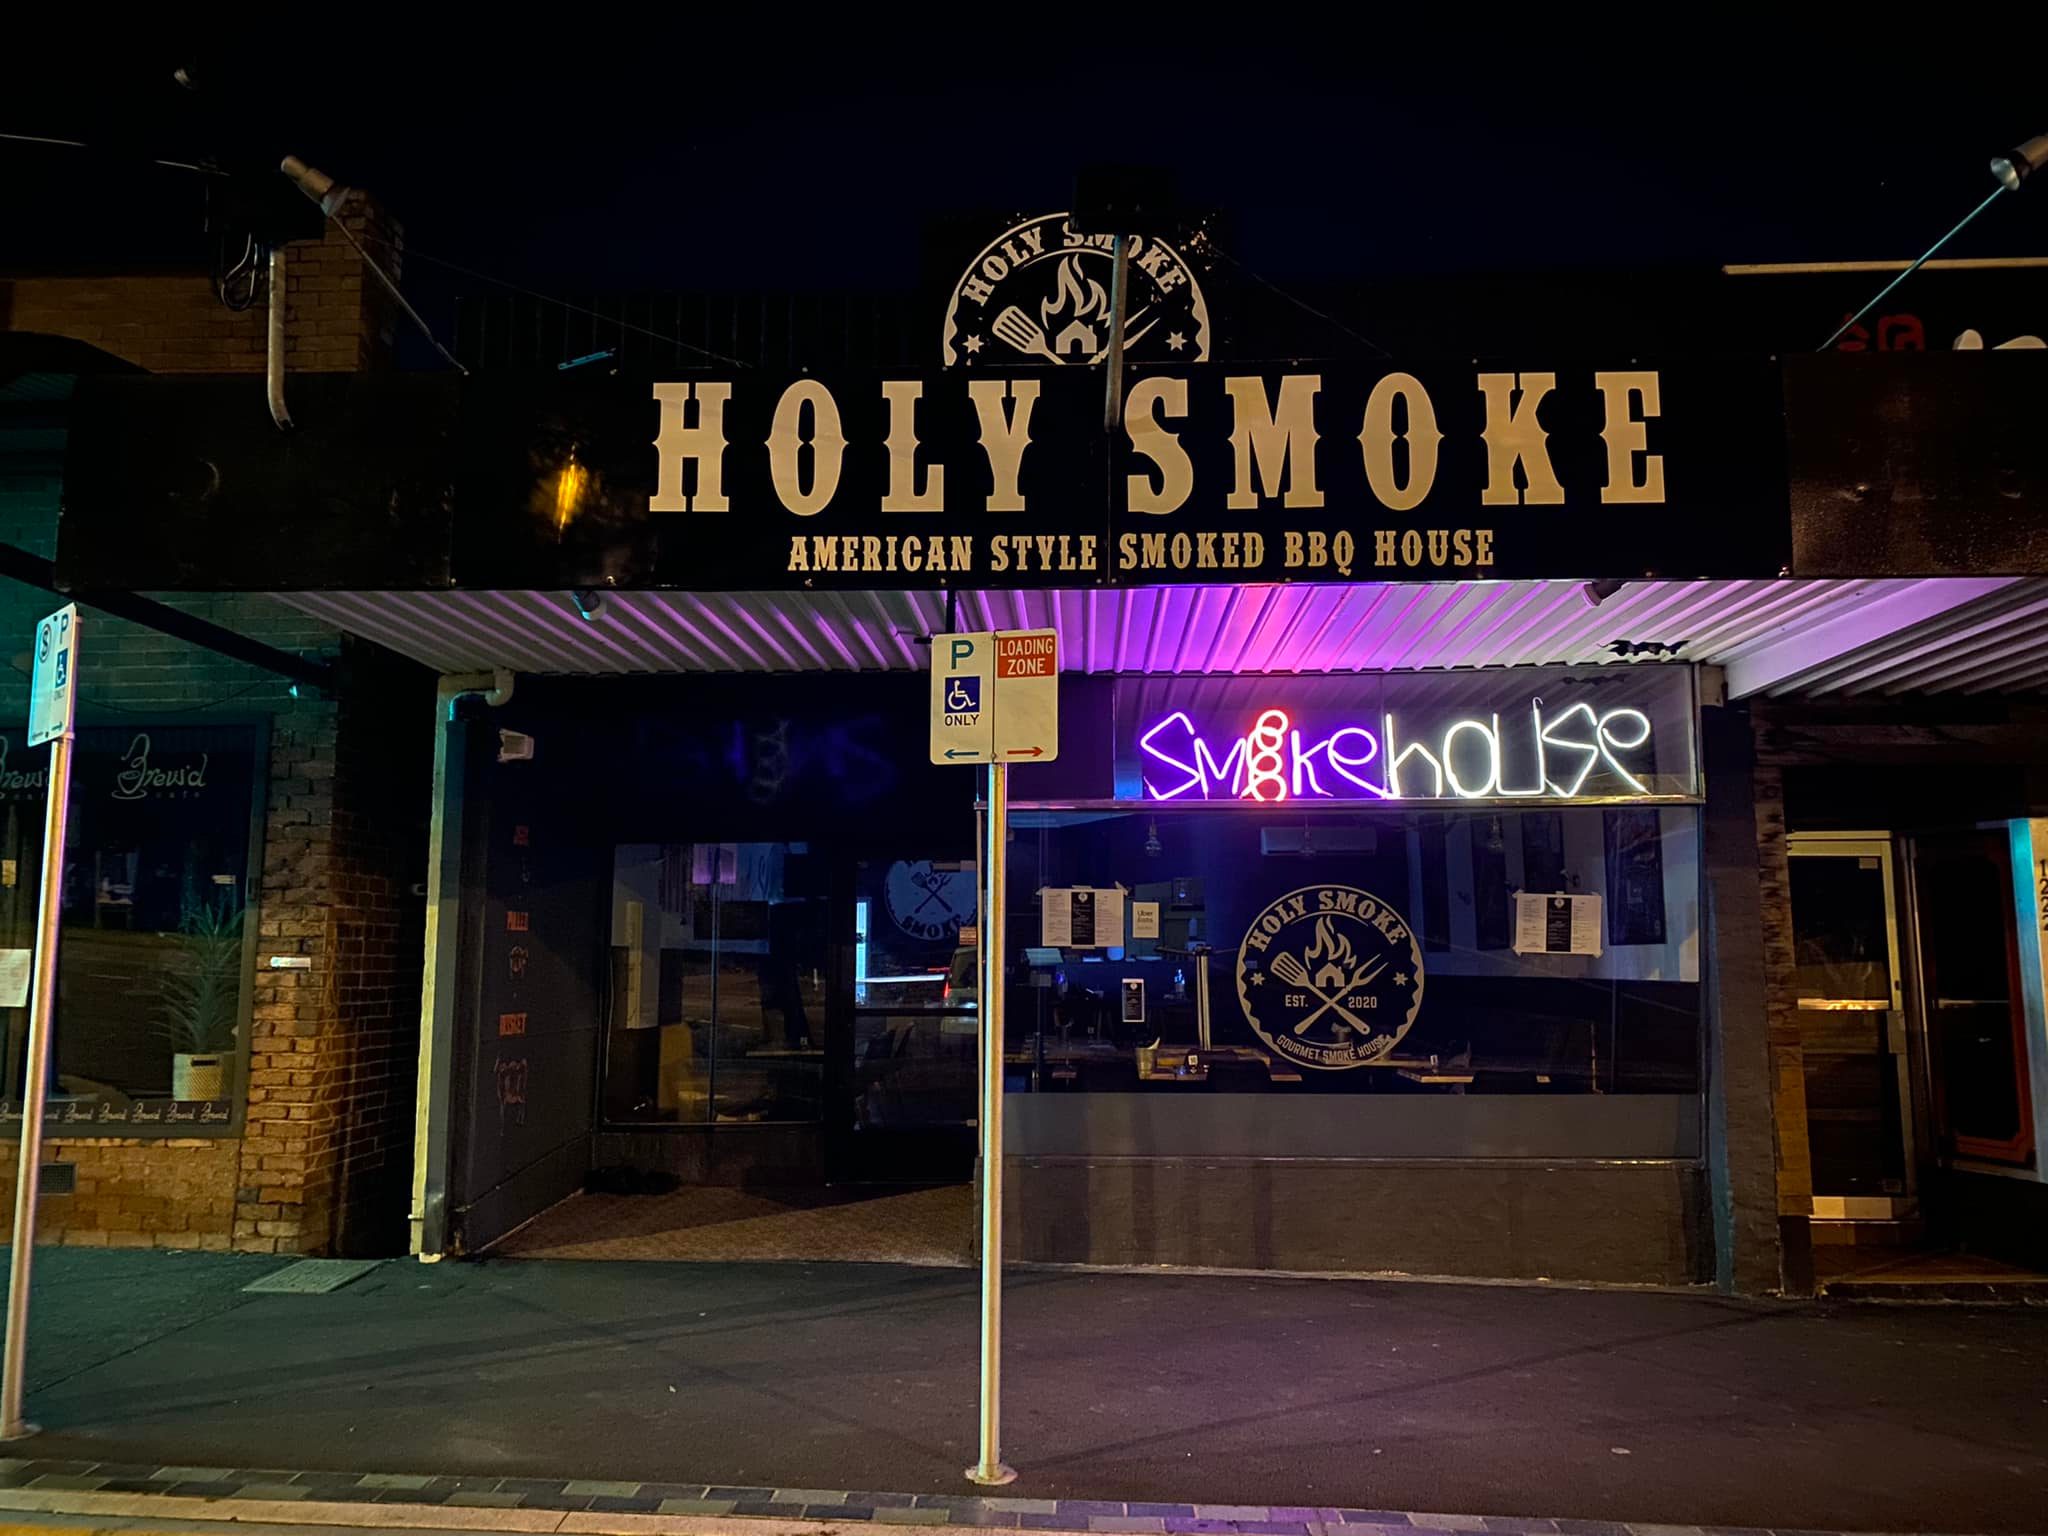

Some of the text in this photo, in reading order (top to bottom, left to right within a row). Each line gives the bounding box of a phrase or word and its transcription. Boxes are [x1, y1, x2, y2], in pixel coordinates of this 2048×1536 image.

[961, 226, 1045, 306] HOLY
[649, 371, 1667, 517] HOLY SMOKE
[787, 528, 1495, 577] AMERICAN STYLE SMOKED BBQ HOUSE
[951, 640, 975, 669] P
[999, 638, 1054, 657] LOADING
[1007, 658, 1047, 676] ZONE
[944, 714, 980, 726] ONLY
[1247, 891, 1408, 952] HOLY SMOKE
[1284, 993, 1309, 1008] EST.
[1348, 995, 1378, 1009] 2020
[1276, 1034, 1321, 1061] GOURMET
[1322, 1047, 1358, 1062] SMOKE
